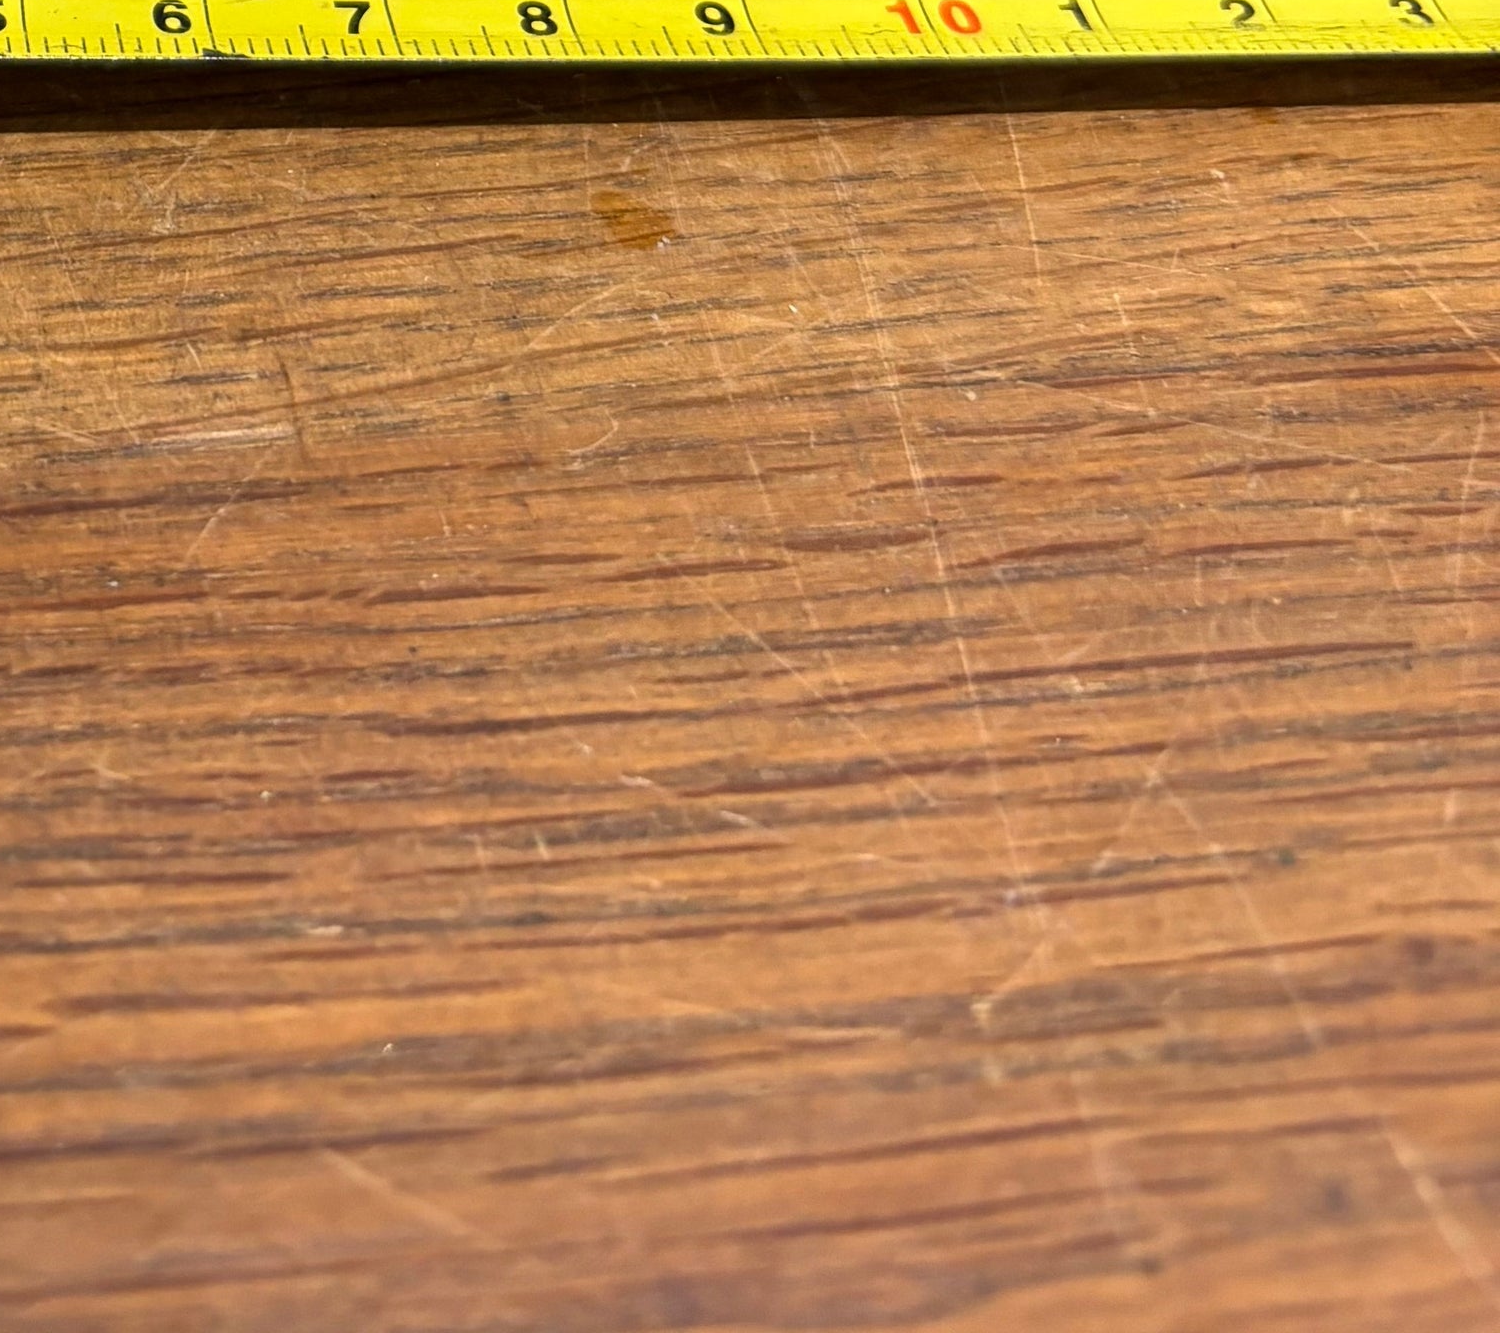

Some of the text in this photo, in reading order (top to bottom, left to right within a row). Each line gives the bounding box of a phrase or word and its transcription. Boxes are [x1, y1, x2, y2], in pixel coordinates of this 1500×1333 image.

[152, 0, 192, 35] 6
[334, 0, 370, 35] 7
[519, 1, 560, 36] 8
[694, 1, 735, 36] 9
